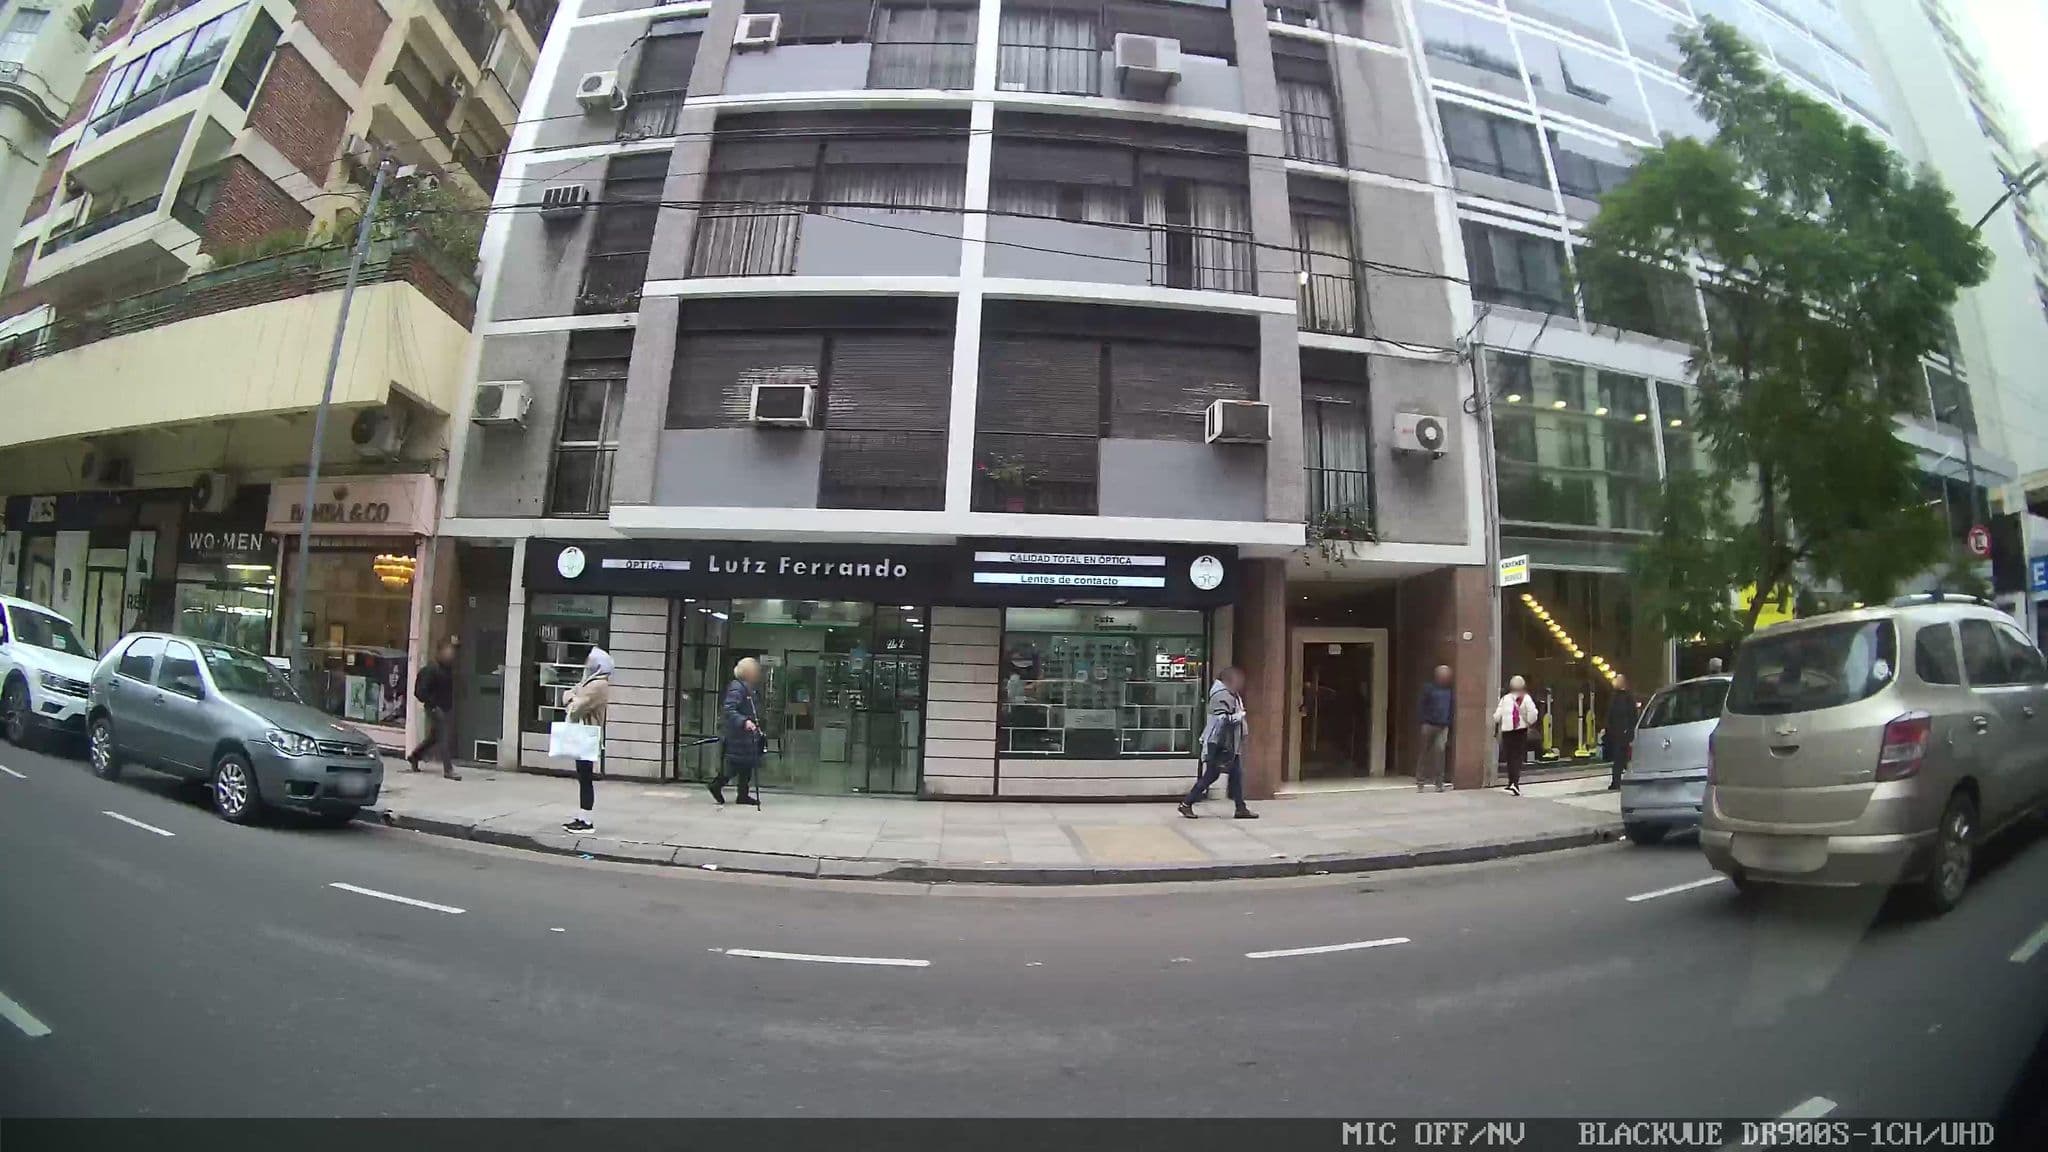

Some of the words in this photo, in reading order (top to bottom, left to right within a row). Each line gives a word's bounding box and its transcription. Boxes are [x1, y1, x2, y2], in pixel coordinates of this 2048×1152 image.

[1009, 553, 1050, 564] CALIDAD
[1053, 554, 1081, 565] TOTAL
[1083, 555, 1097, 565] EN
[708, 555, 767, 574] Lutz
[779, 556, 908, 578] Ferrando
[1021, 575, 1055, 584] Lentes
[1058, 576, 1071, 585] de
[1074, 576, 1118, 586] contacto
